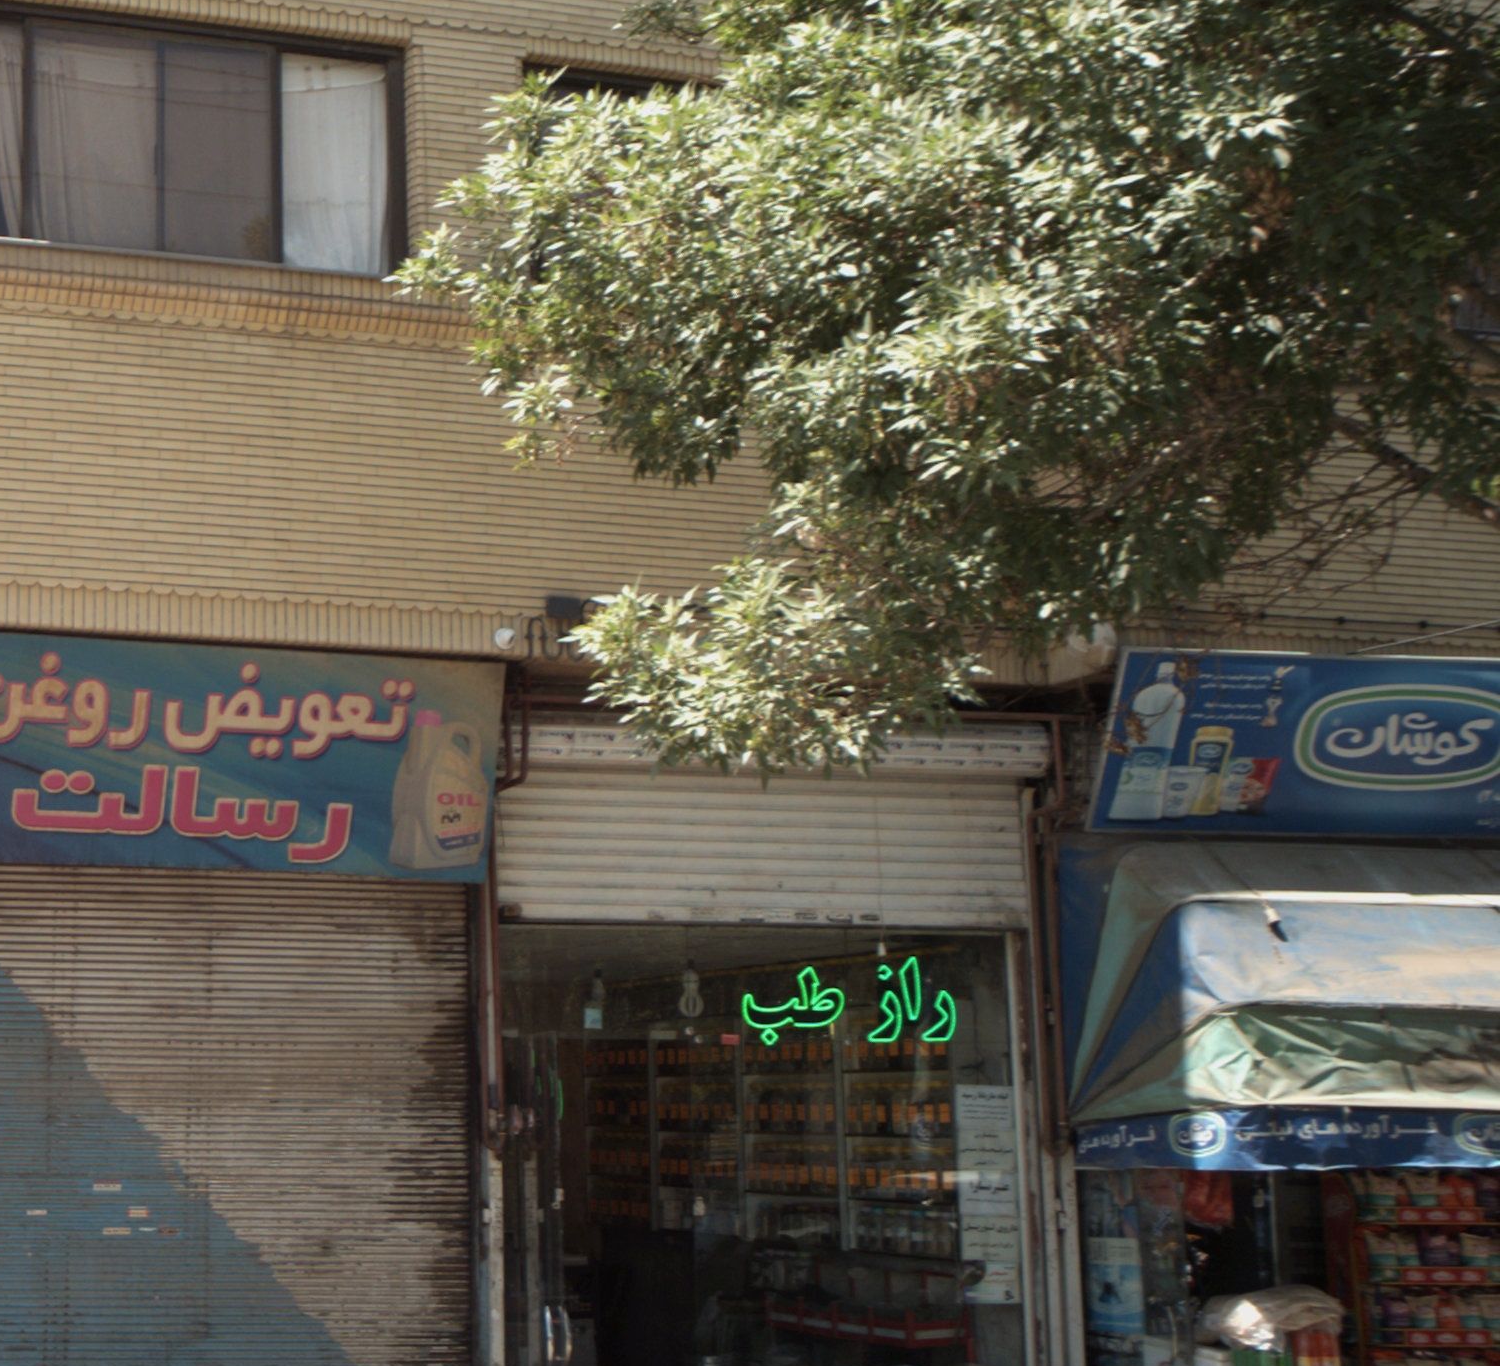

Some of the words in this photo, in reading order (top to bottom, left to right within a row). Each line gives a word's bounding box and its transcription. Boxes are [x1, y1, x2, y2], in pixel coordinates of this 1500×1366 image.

[164, 661, 418, 758] تعویض
[11, 764, 354, 863] رسالت
[437, 792, 480, 806] OIL
[741, 965, 845, 1045] طب
[868, 956, 957, 1042] راز
